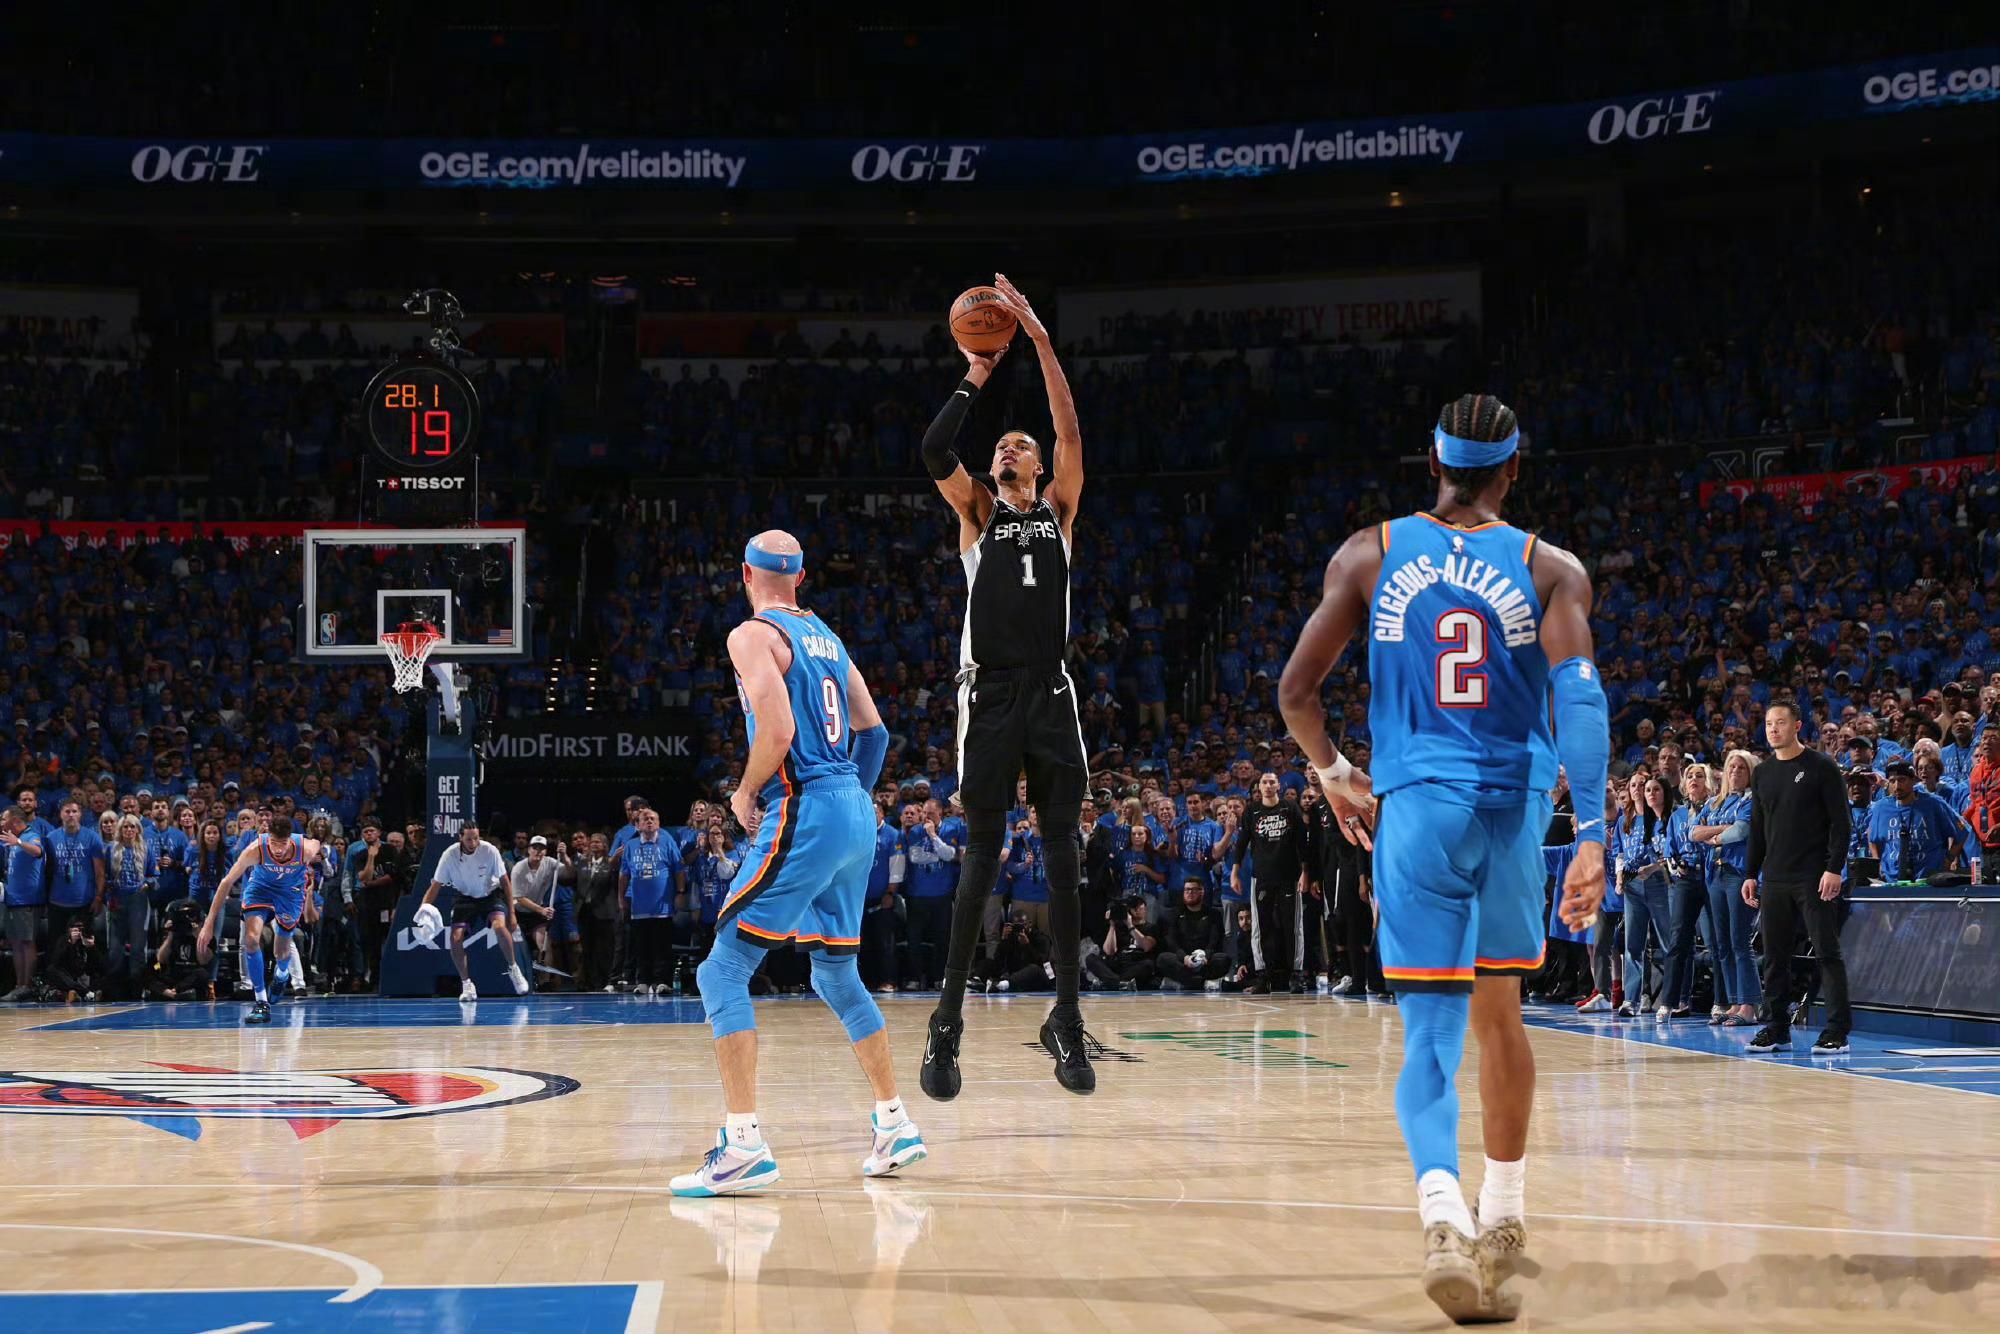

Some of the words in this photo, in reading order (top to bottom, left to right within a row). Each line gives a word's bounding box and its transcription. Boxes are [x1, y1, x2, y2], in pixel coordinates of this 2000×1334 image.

[420, 144, 746, 187] OGE.com/reliability
[1137, 125, 1463, 173] OGE.com/reliability
[384, 383, 440, 409] 28.1
[410, 410, 452, 457] 19
[995, 520, 1056, 544] SPURS
[1021, 553, 1037, 587] 1
[1374, 554, 1537, 648] GILGEOUS-ALEXANDER
[1436, 608, 1488, 708] 2
[822, 677, 842, 745] 9
[617, 732, 690, 757] BANK
[438, 775, 460, 794] GET
[438, 795, 460, 813] THE
